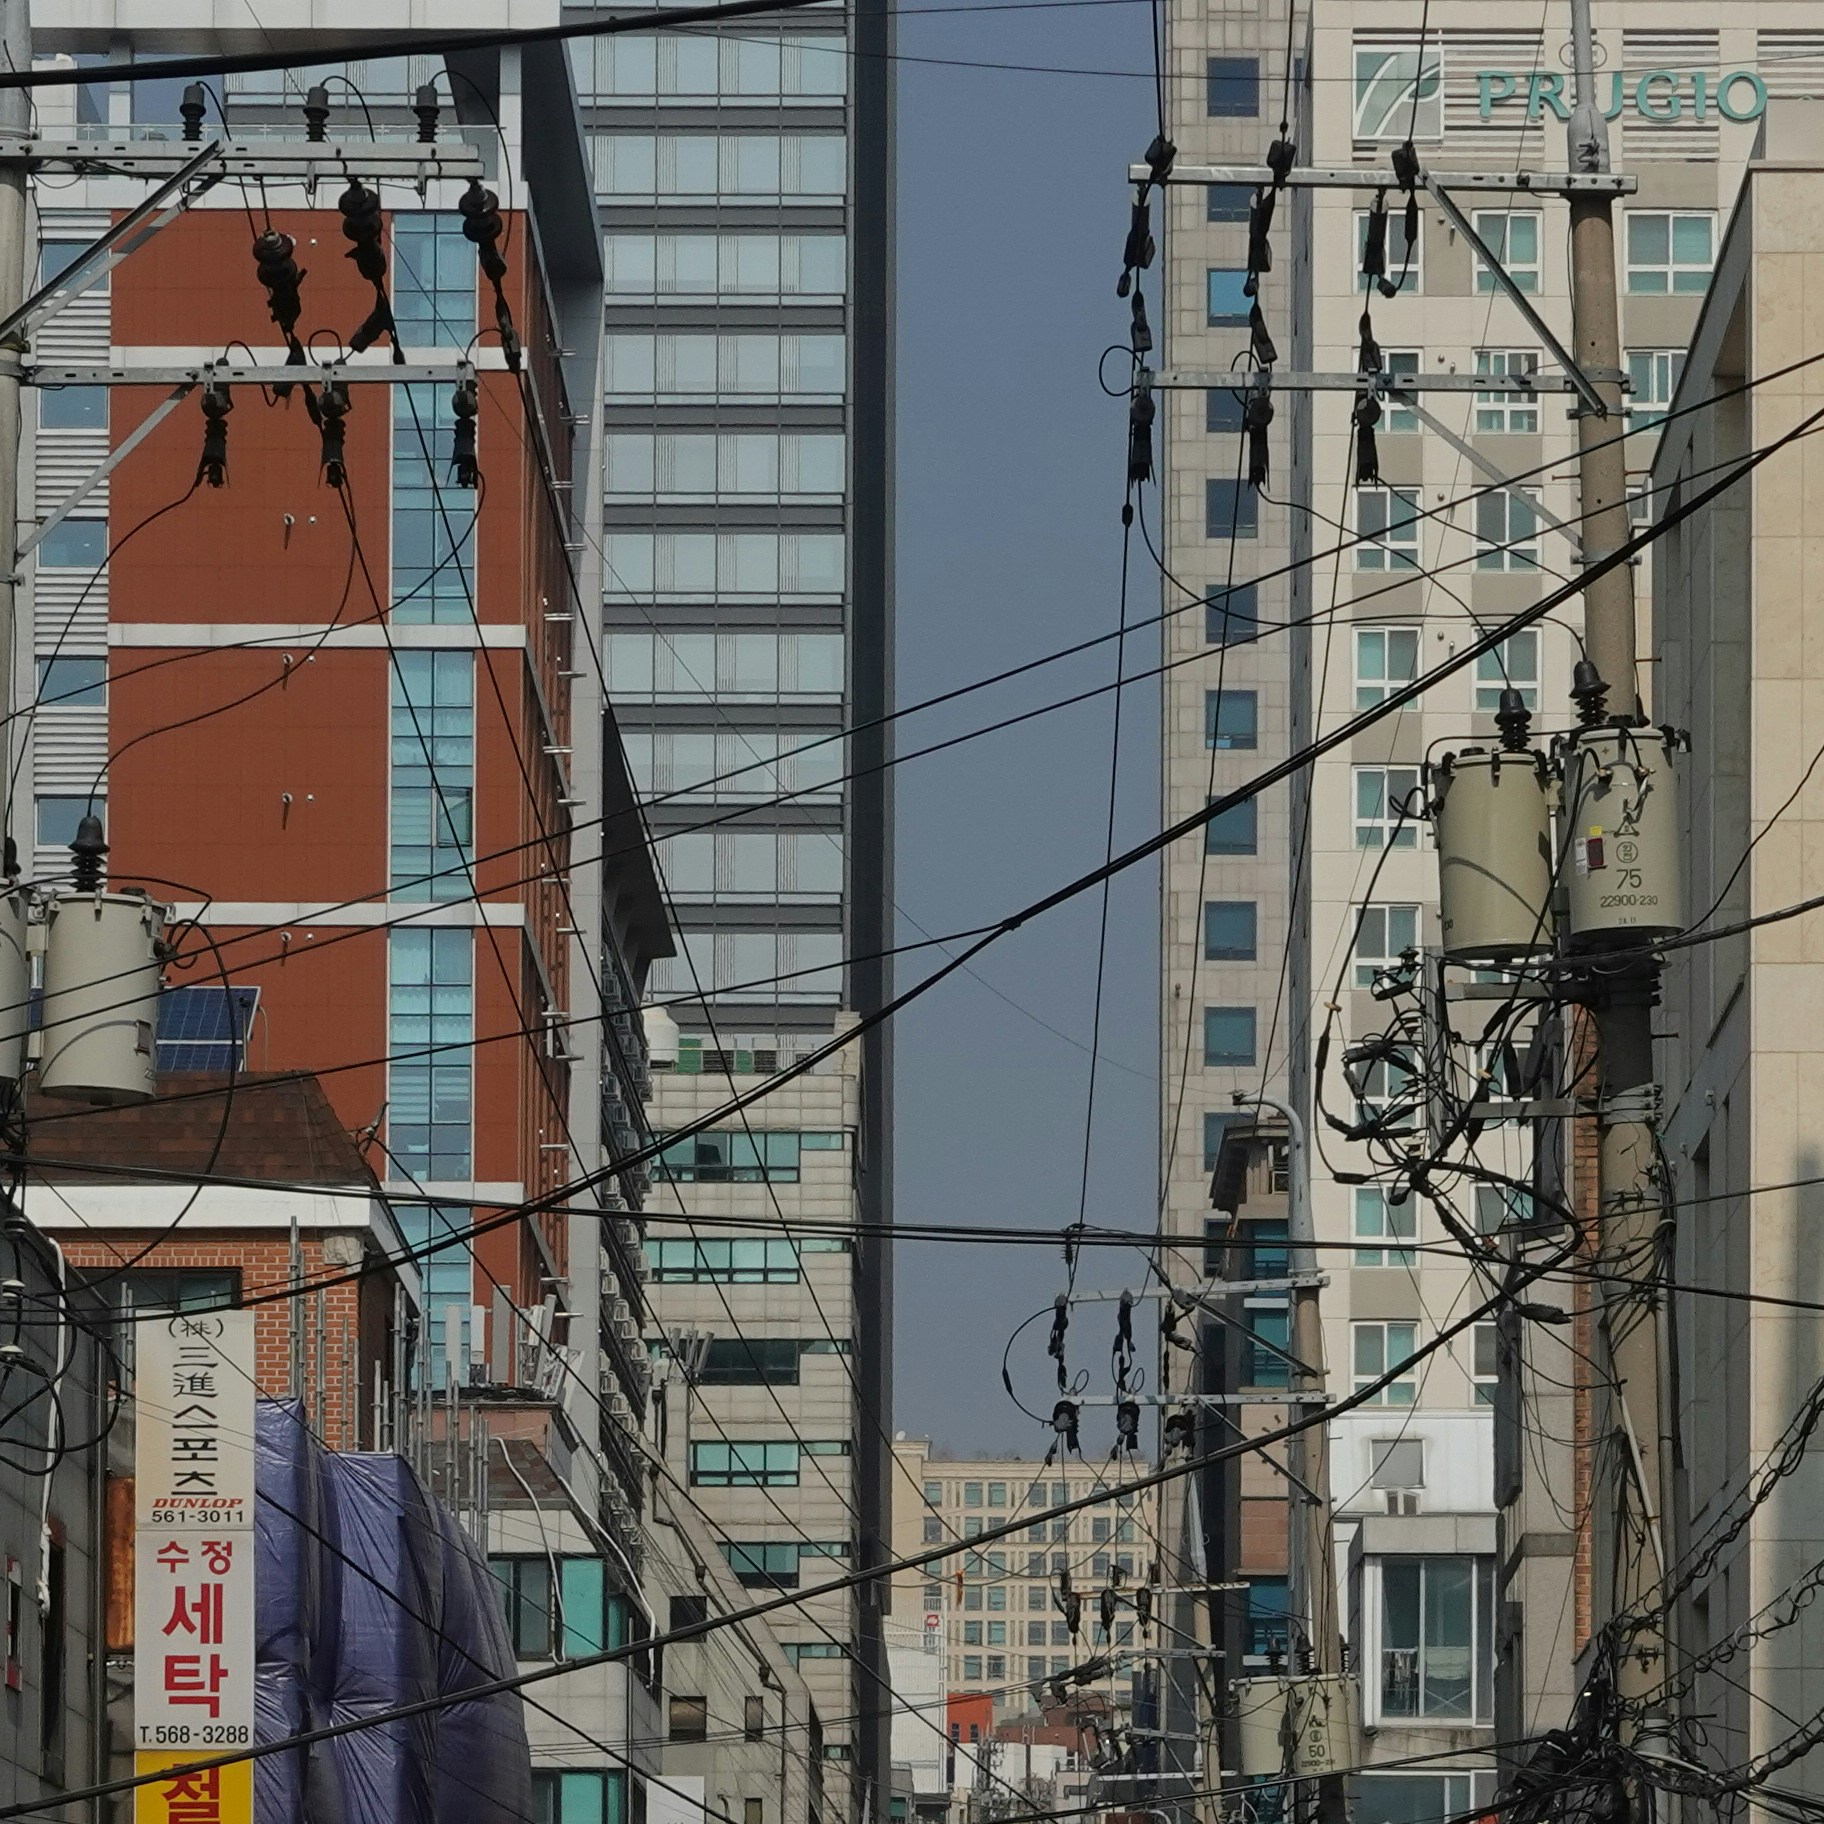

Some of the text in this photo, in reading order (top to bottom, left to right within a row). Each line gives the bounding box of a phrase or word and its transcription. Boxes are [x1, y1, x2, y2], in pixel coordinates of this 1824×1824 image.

[1616, 868, 1643, 890] 75
[151, 1498, 244, 1509] DUNLOP
[151, 1510, 244, 1523] 561-3011
[156, 1540, 233, 1576] 수정
[161, 1582, 229, 1719] 세탁
[139, 1725, 249, 1745] T.568-3288
